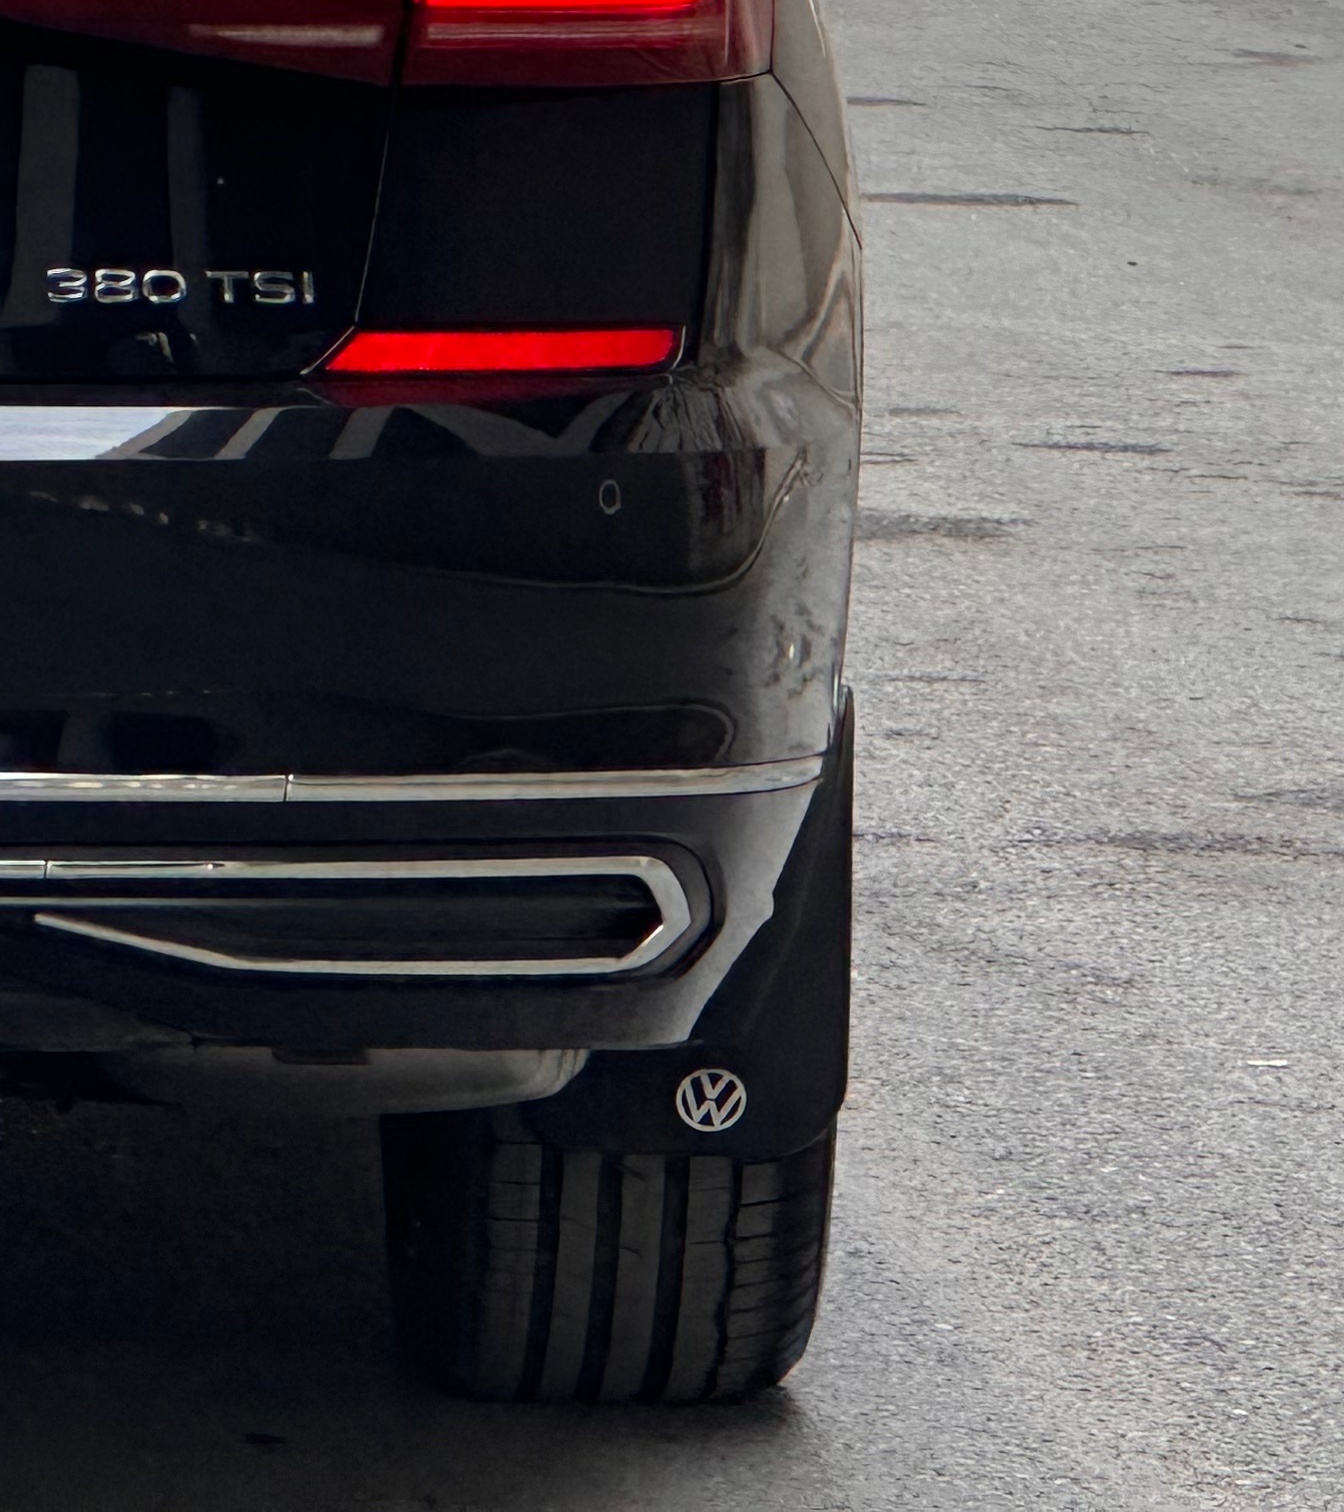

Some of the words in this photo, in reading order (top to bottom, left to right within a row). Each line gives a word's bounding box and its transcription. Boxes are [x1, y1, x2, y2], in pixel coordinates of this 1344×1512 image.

[46, 268, 187, 304] 380
[205, 269, 315, 305] TSI
[676, 1068, 747, 1132] VW
